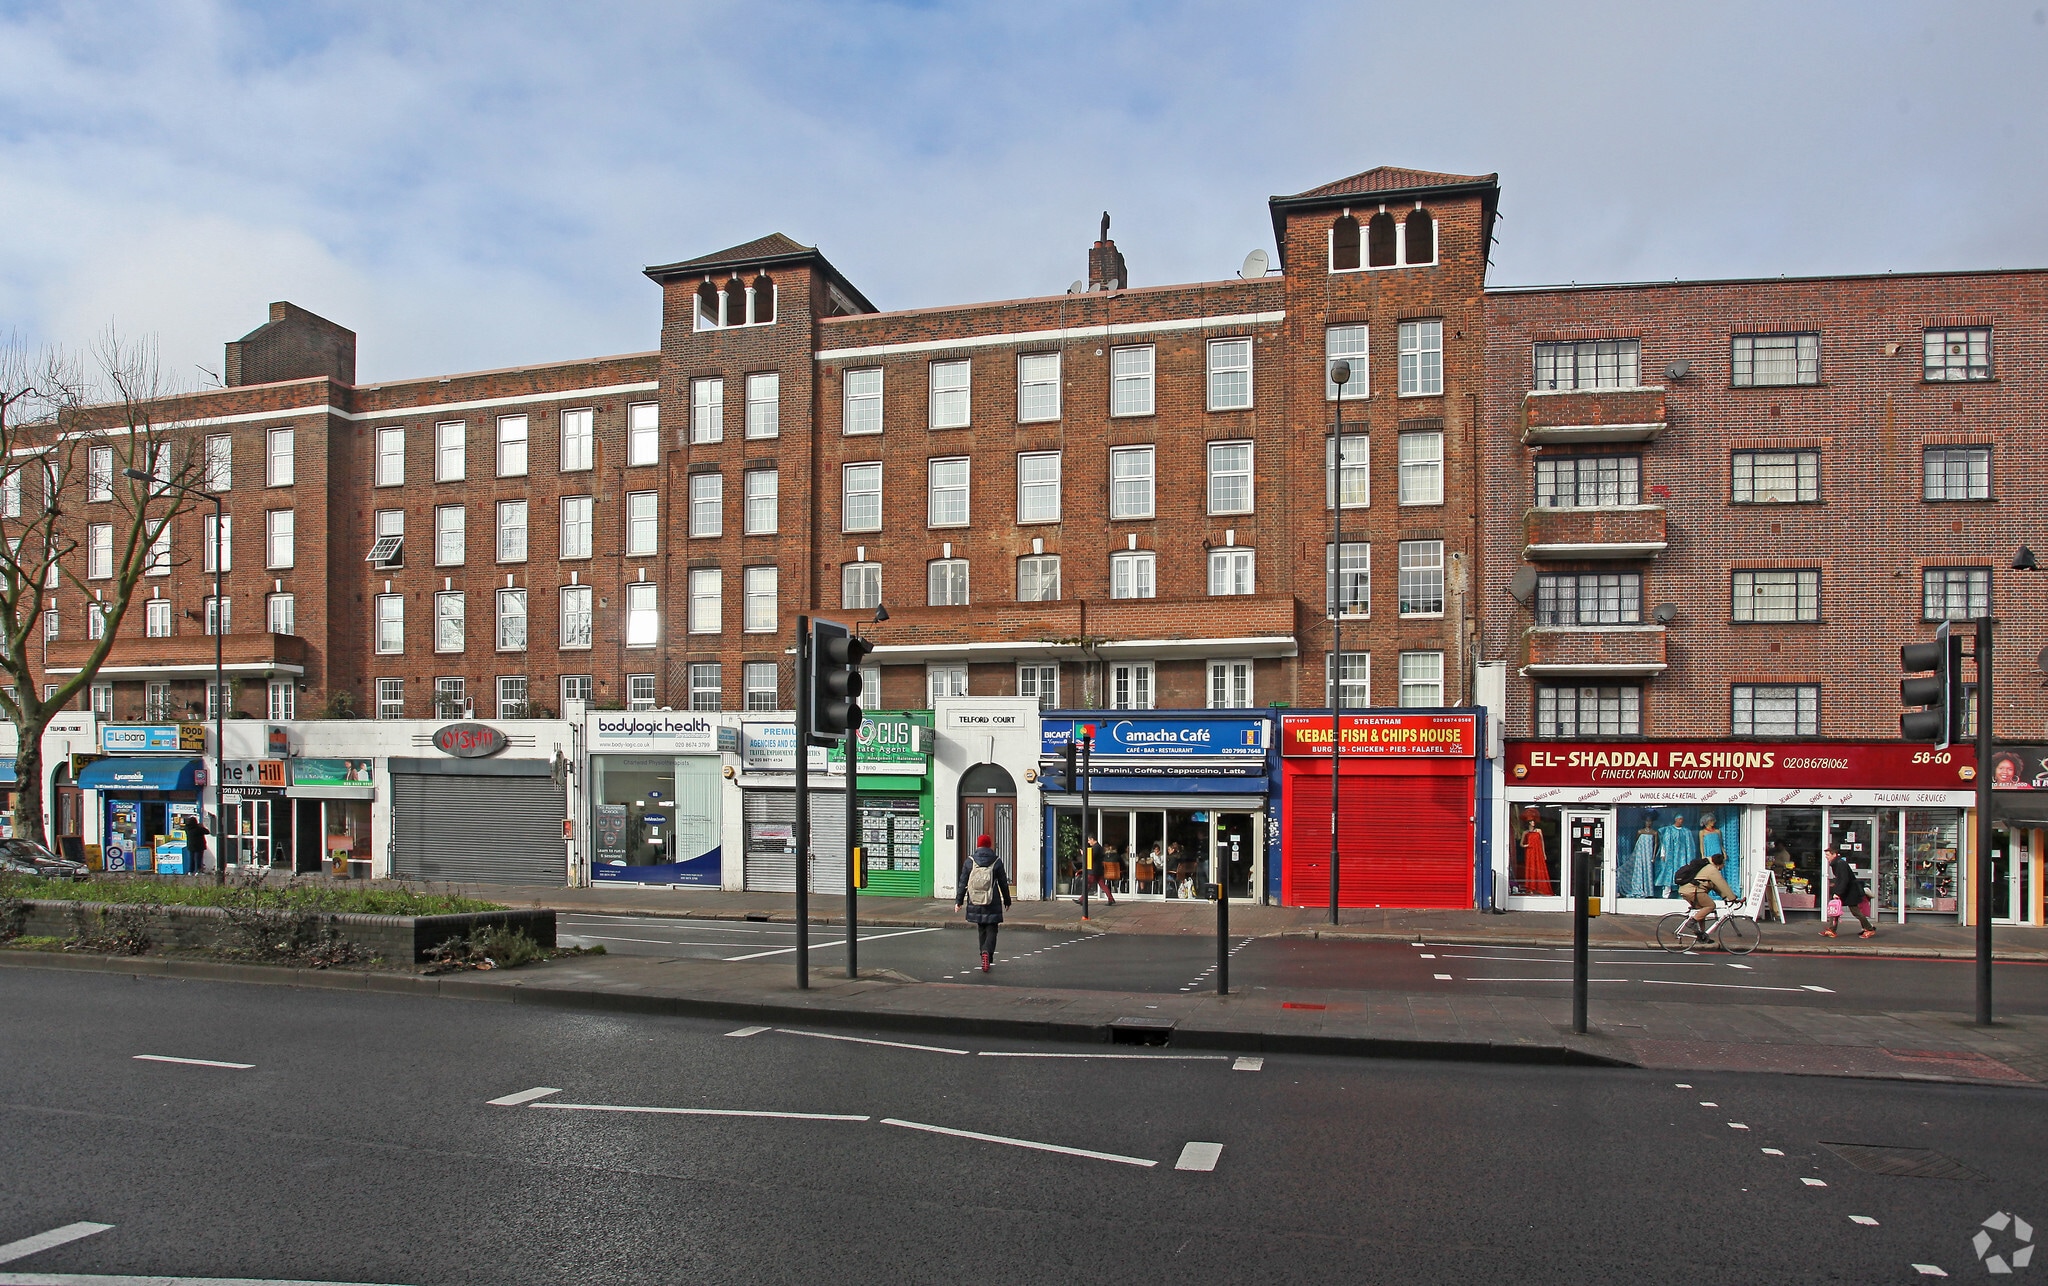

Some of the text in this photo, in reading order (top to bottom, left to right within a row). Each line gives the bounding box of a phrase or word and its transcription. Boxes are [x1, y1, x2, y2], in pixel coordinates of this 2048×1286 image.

[181, 727, 203, 735] FOOD
[599, 717, 711, 735] bodylogic health
[114, 733, 145, 742] Lebara
[763, 728, 797, 736] PREMIU
[1113, 720, 1211, 744] Camacha Café
[1296, 729, 1461, 743] KEBAB FISH & CHIPS HOUSE
[181, 741, 203, 749] DRINK
[750, 739, 776, 747] AGENCIES
[777, 739, 789, 747] AND
[879, 746, 906, 754] Agent
[1531, 751, 1775, 768] EL-SHADDAI FASHIONS
[1783, 757, 1849, 769] 02086781062
[1911, 752, 1951, 765] 58-60
[223, 763, 281, 780] he Hill
[1600, 769, 1635, 779] FINETEX
[1637, 769, 1671, 779] FASHION
[1673, 770, 1713, 780] SOLUTION
[247, 788, 262, 796] 1773
[1577, 789, 1600, 802] ORGANZA
[1640, 792, 1660, 800] WHOLE
[1873, 793, 1947, 802] TAILORING SERVICES
[1809, 791, 1824, 805] SHOE
